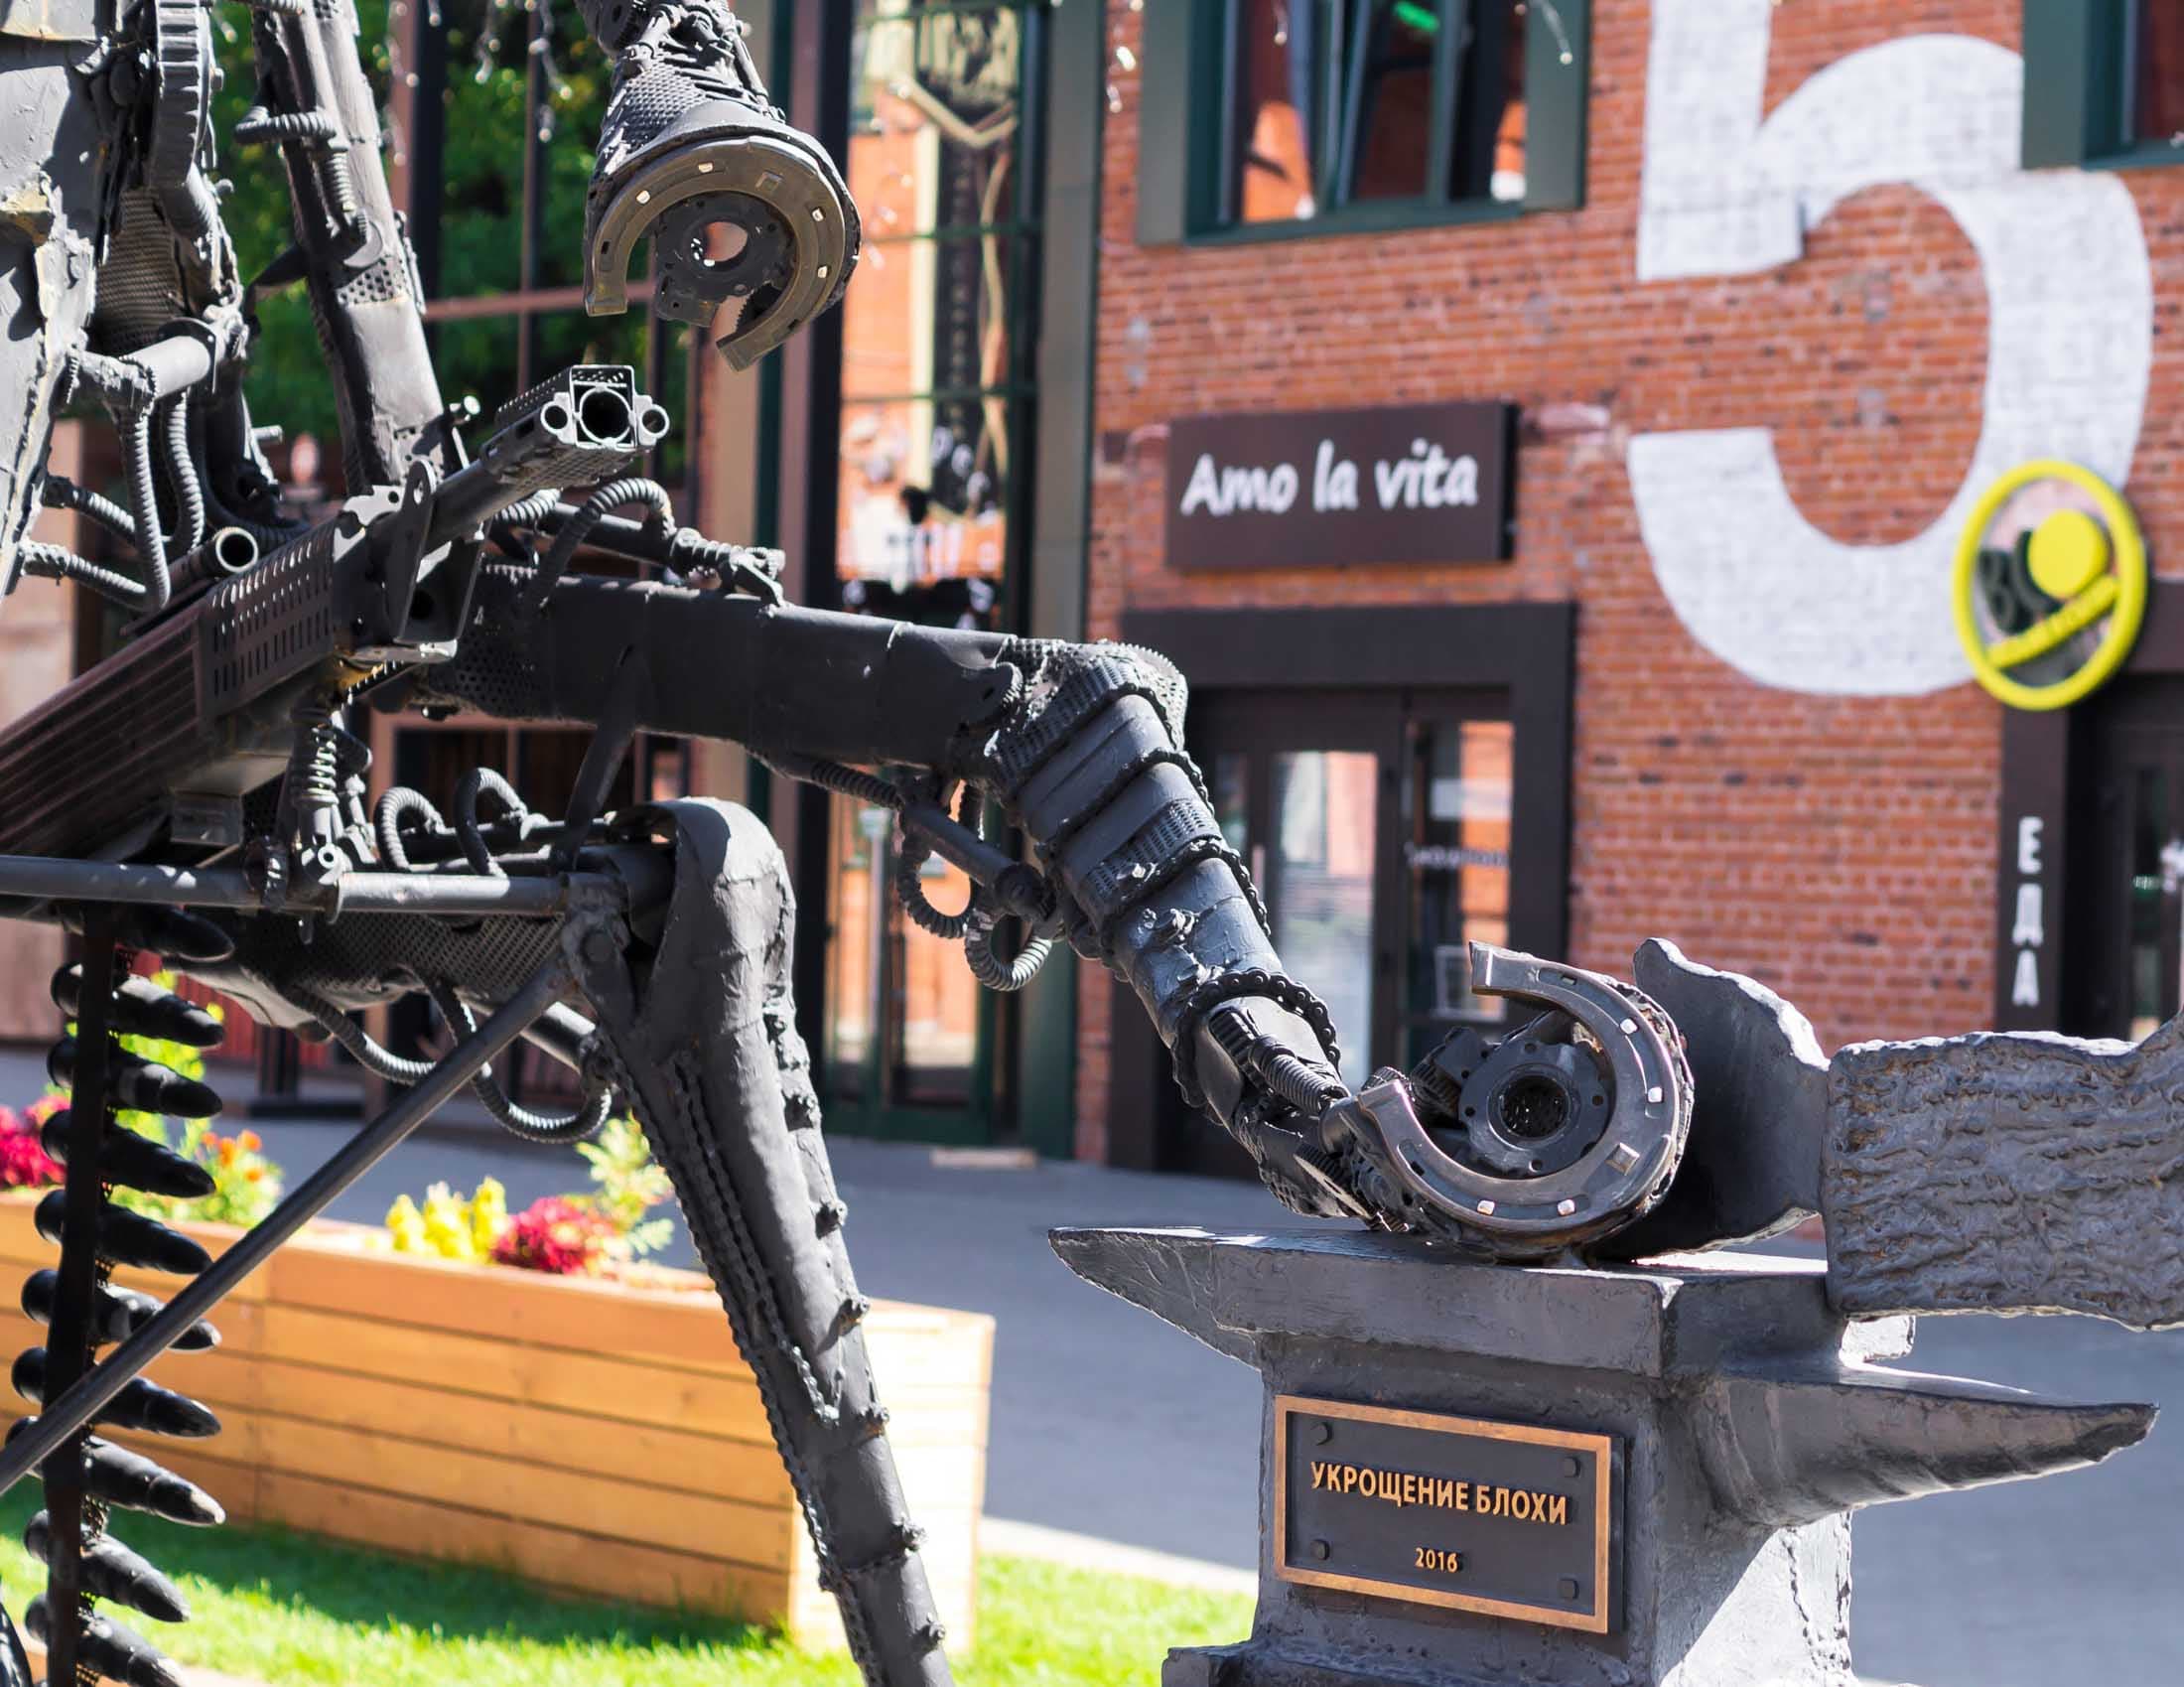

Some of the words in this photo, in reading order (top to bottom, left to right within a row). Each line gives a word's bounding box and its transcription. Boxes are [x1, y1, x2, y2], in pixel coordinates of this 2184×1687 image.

[1180, 453, 1297, 515] Amo
[1312, 439, 1358, 511] la
[1375, 437, 1479, 509] vita
[1310, 1461, 1468, 1510] УКРОЩЕНИЕ
[1476, 1485, 1568, 1525] БЛОХИ
[1415, 1547, 1458, 1574] 2016
